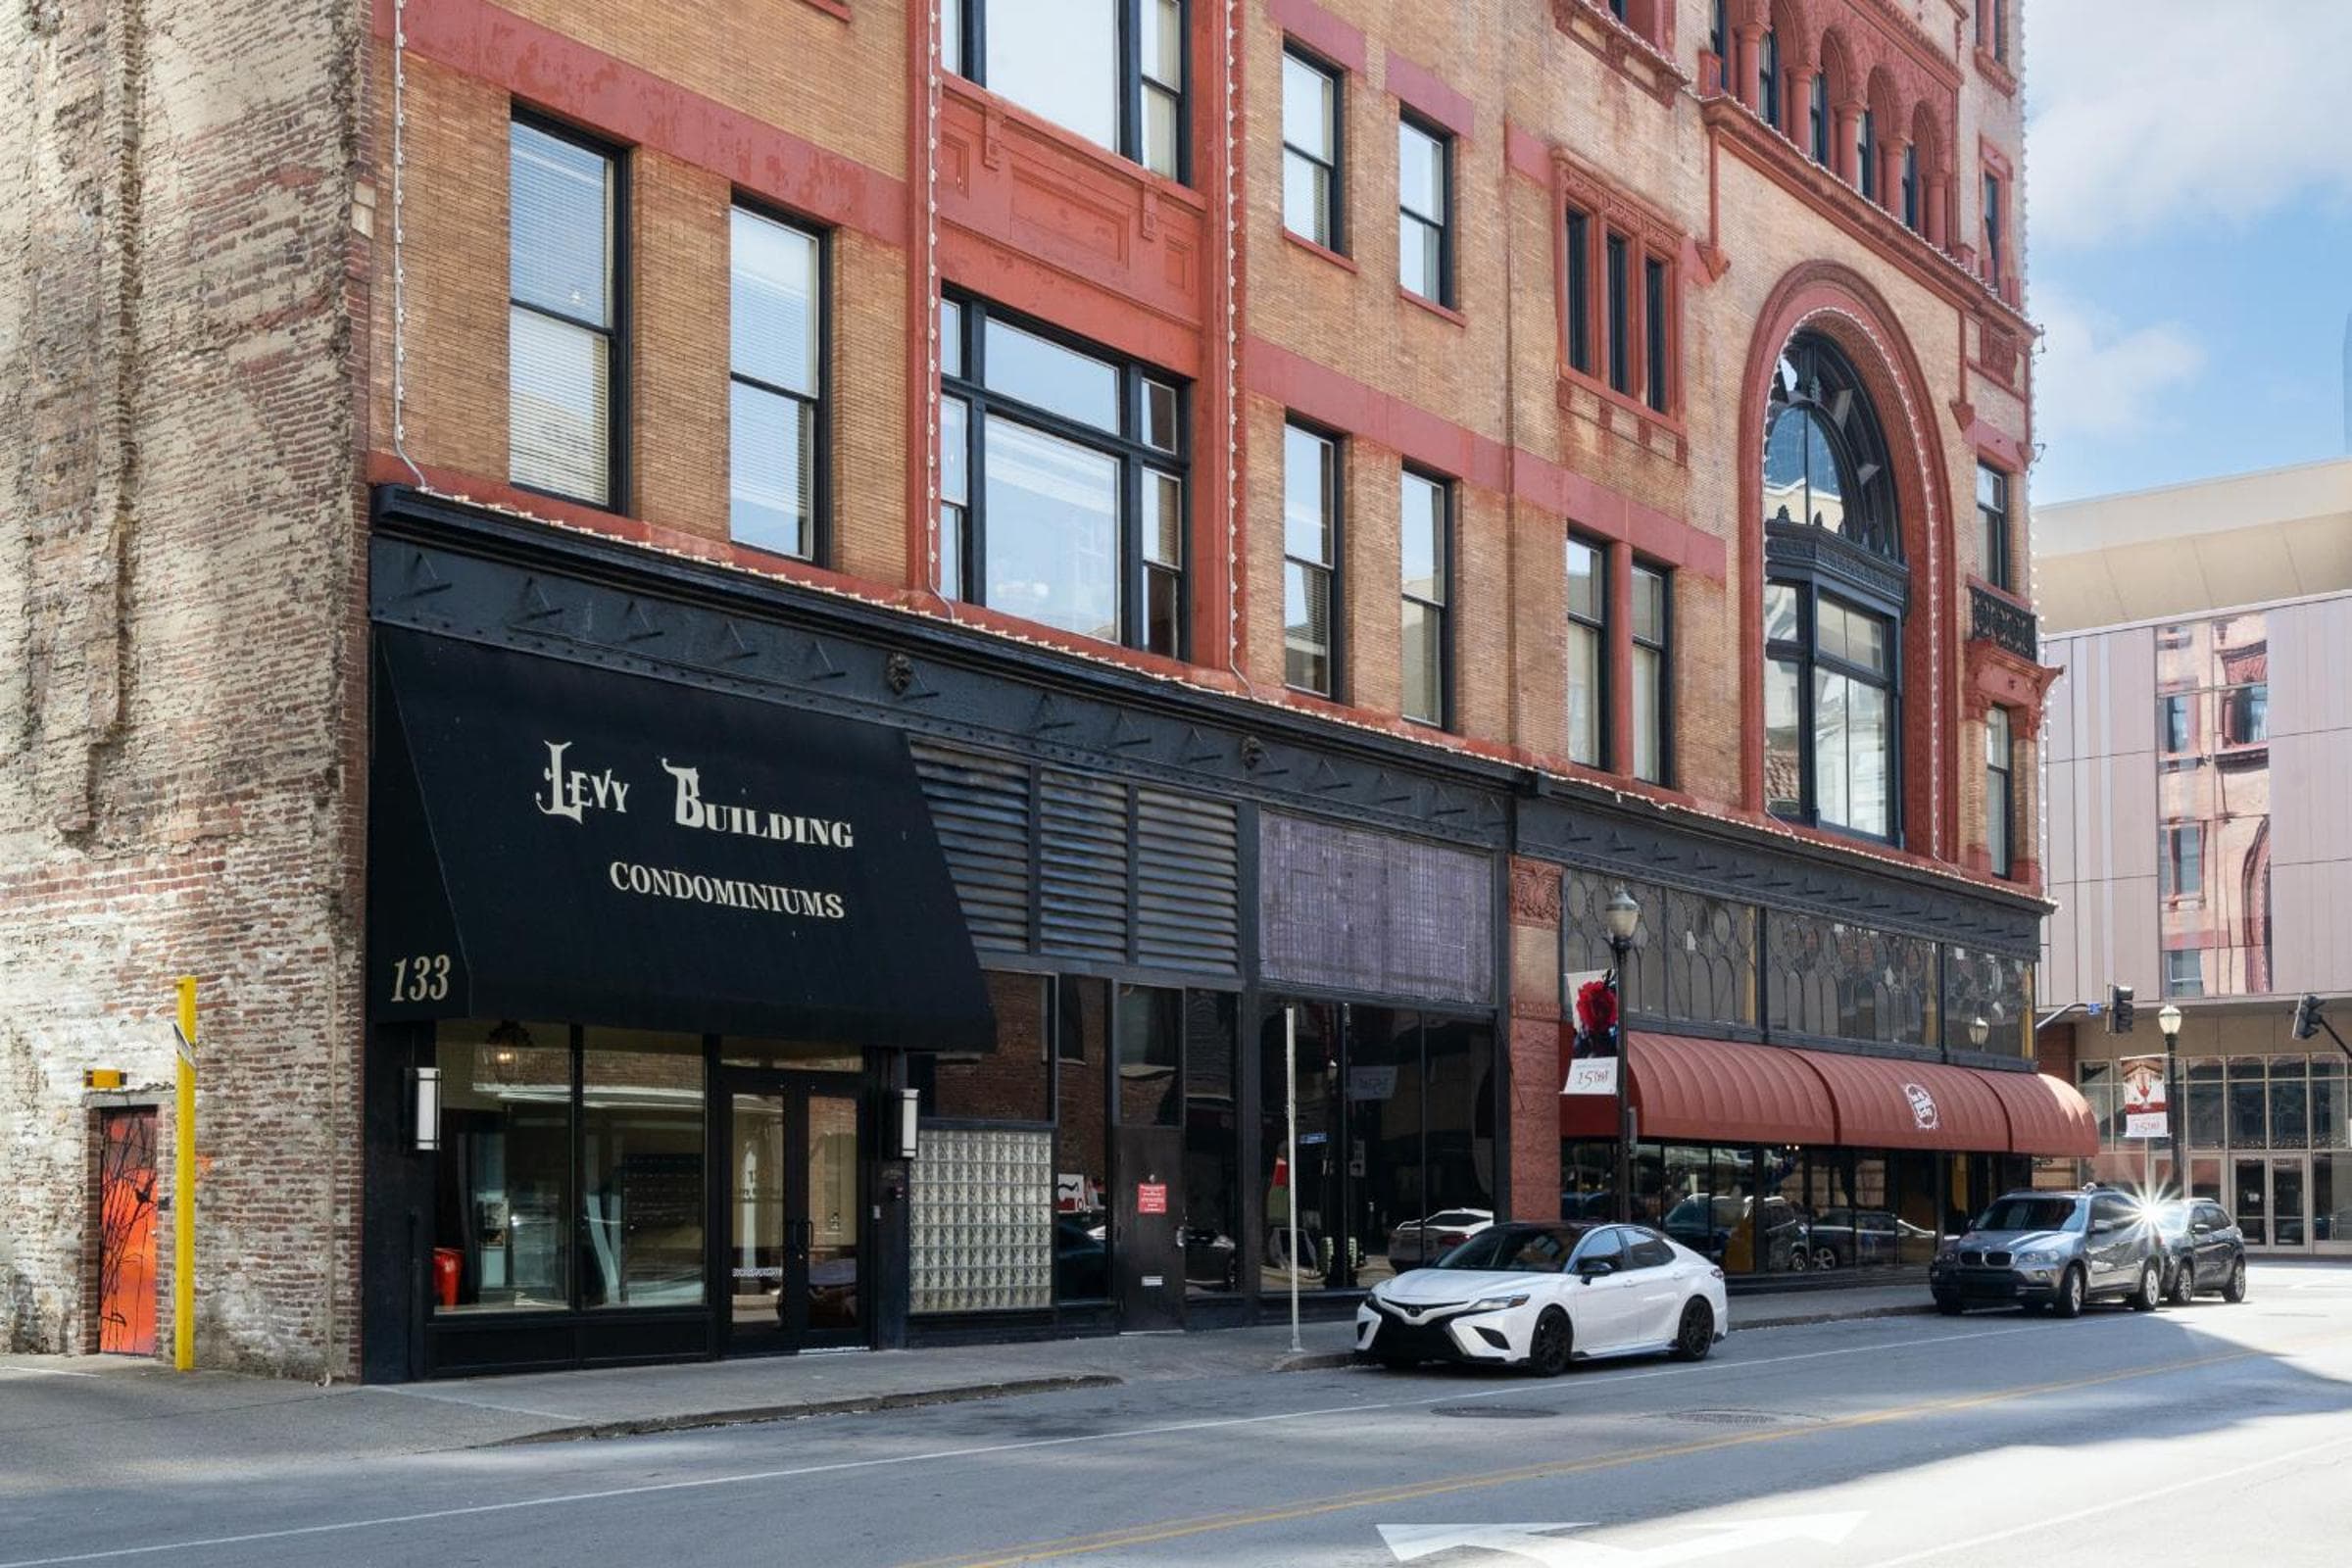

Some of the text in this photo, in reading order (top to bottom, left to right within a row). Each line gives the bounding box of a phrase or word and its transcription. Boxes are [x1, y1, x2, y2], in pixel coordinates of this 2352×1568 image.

[661, 757, 855, 849] BUILDING
[610, 860, 845, 919] CONDOMINIUMS
[391, 954, 451, 1002] 133
